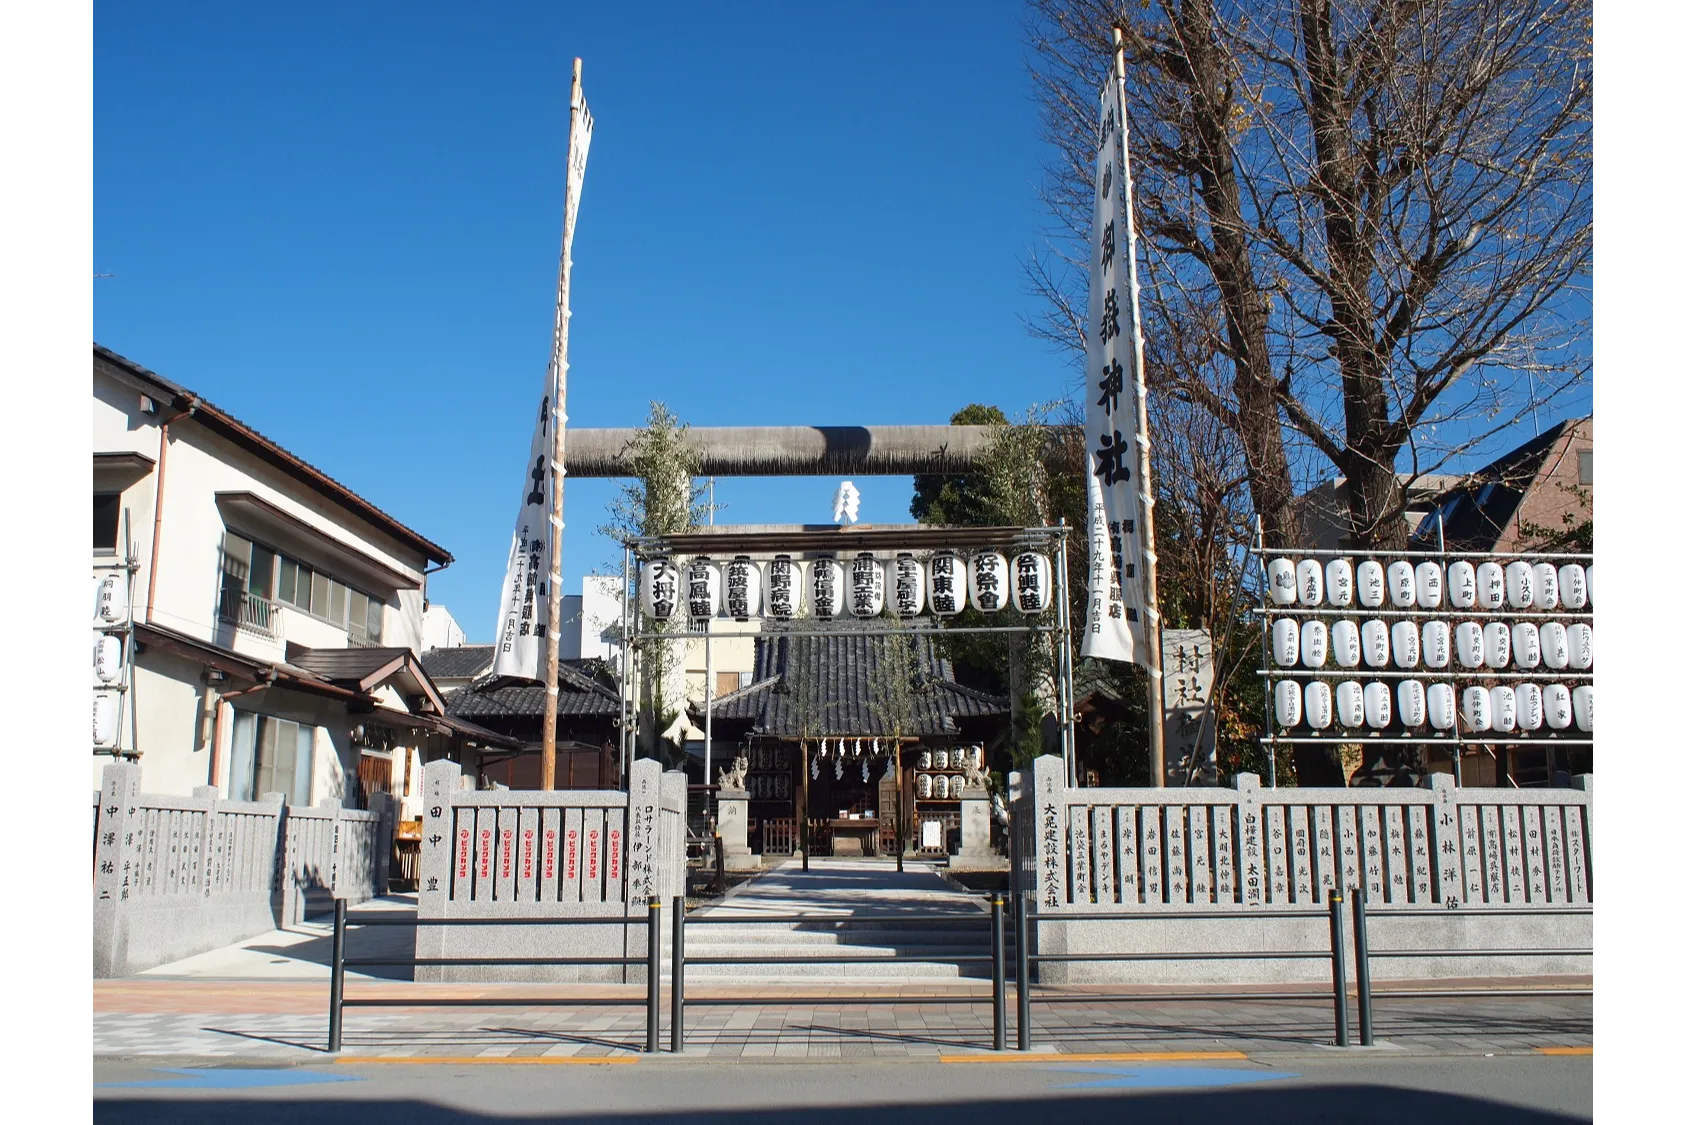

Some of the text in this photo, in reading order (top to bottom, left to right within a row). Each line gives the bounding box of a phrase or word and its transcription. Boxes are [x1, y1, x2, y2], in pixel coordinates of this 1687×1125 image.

[1091, 503, 1105, 635] 平成二十九年十一月吉日
[770, 560, 793, 617] 関野病院
[1338, 577, 1348, 601] 宮元
[1369, 578, 1380, 600] 池三
[1400, 578, 1411, 600] 原町
[1428, 578, 1439, 598] 西一
[1462, 578, 1473, 600] 上町
[1489, 580, 1500, 602] 押田
[1521, 578, 1531, 603] 小久保
[1146, 828, 1158, 893] 岩田信男
[1194, 829, 1207, 893] 宮元睦
